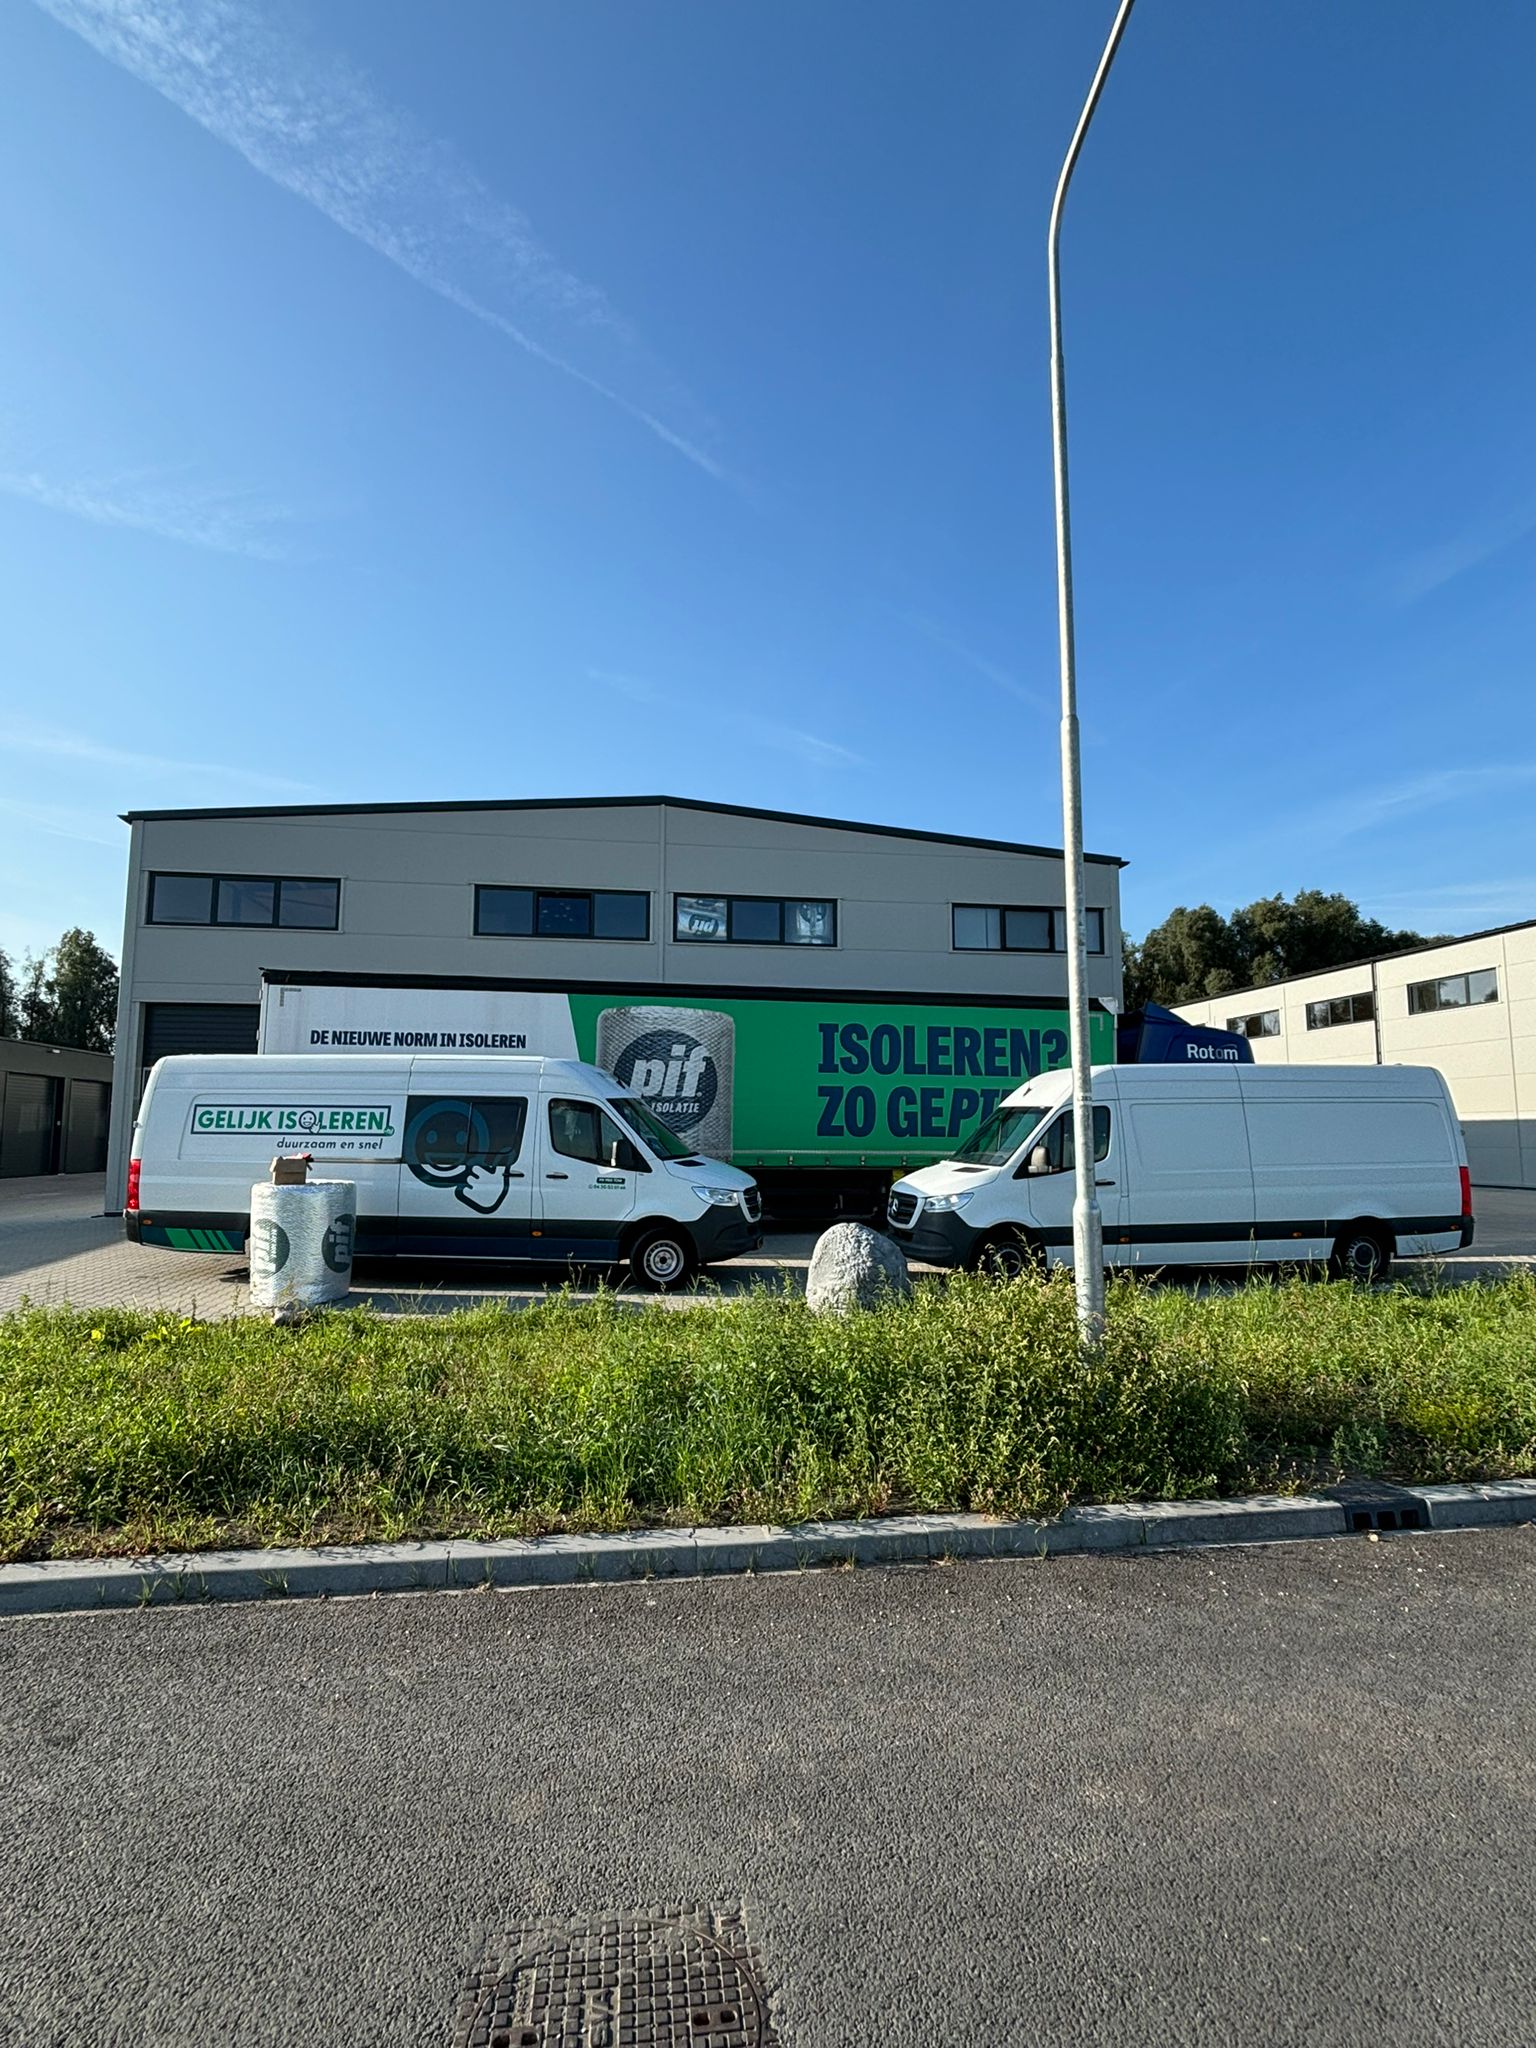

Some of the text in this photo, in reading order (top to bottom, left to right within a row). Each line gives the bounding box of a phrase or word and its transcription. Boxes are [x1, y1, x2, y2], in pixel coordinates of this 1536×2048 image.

[310, 1030, 527, 1048] DE NIEUWE NORM IN ISOLEREN
[818, 1023, 1068, 1077] ISOLEREN?
[1187, 1043, 1239, 1060] Rotom
[651, 1102, 700, 1113] ISOLATIE
[817, 1085, 877, 1137] ZO
[198, 1110, 274, 1129] GELIJK
[276, 1137, 384, 1150] duurzaam en snel
[329, 1221, 352, 1264] pif
